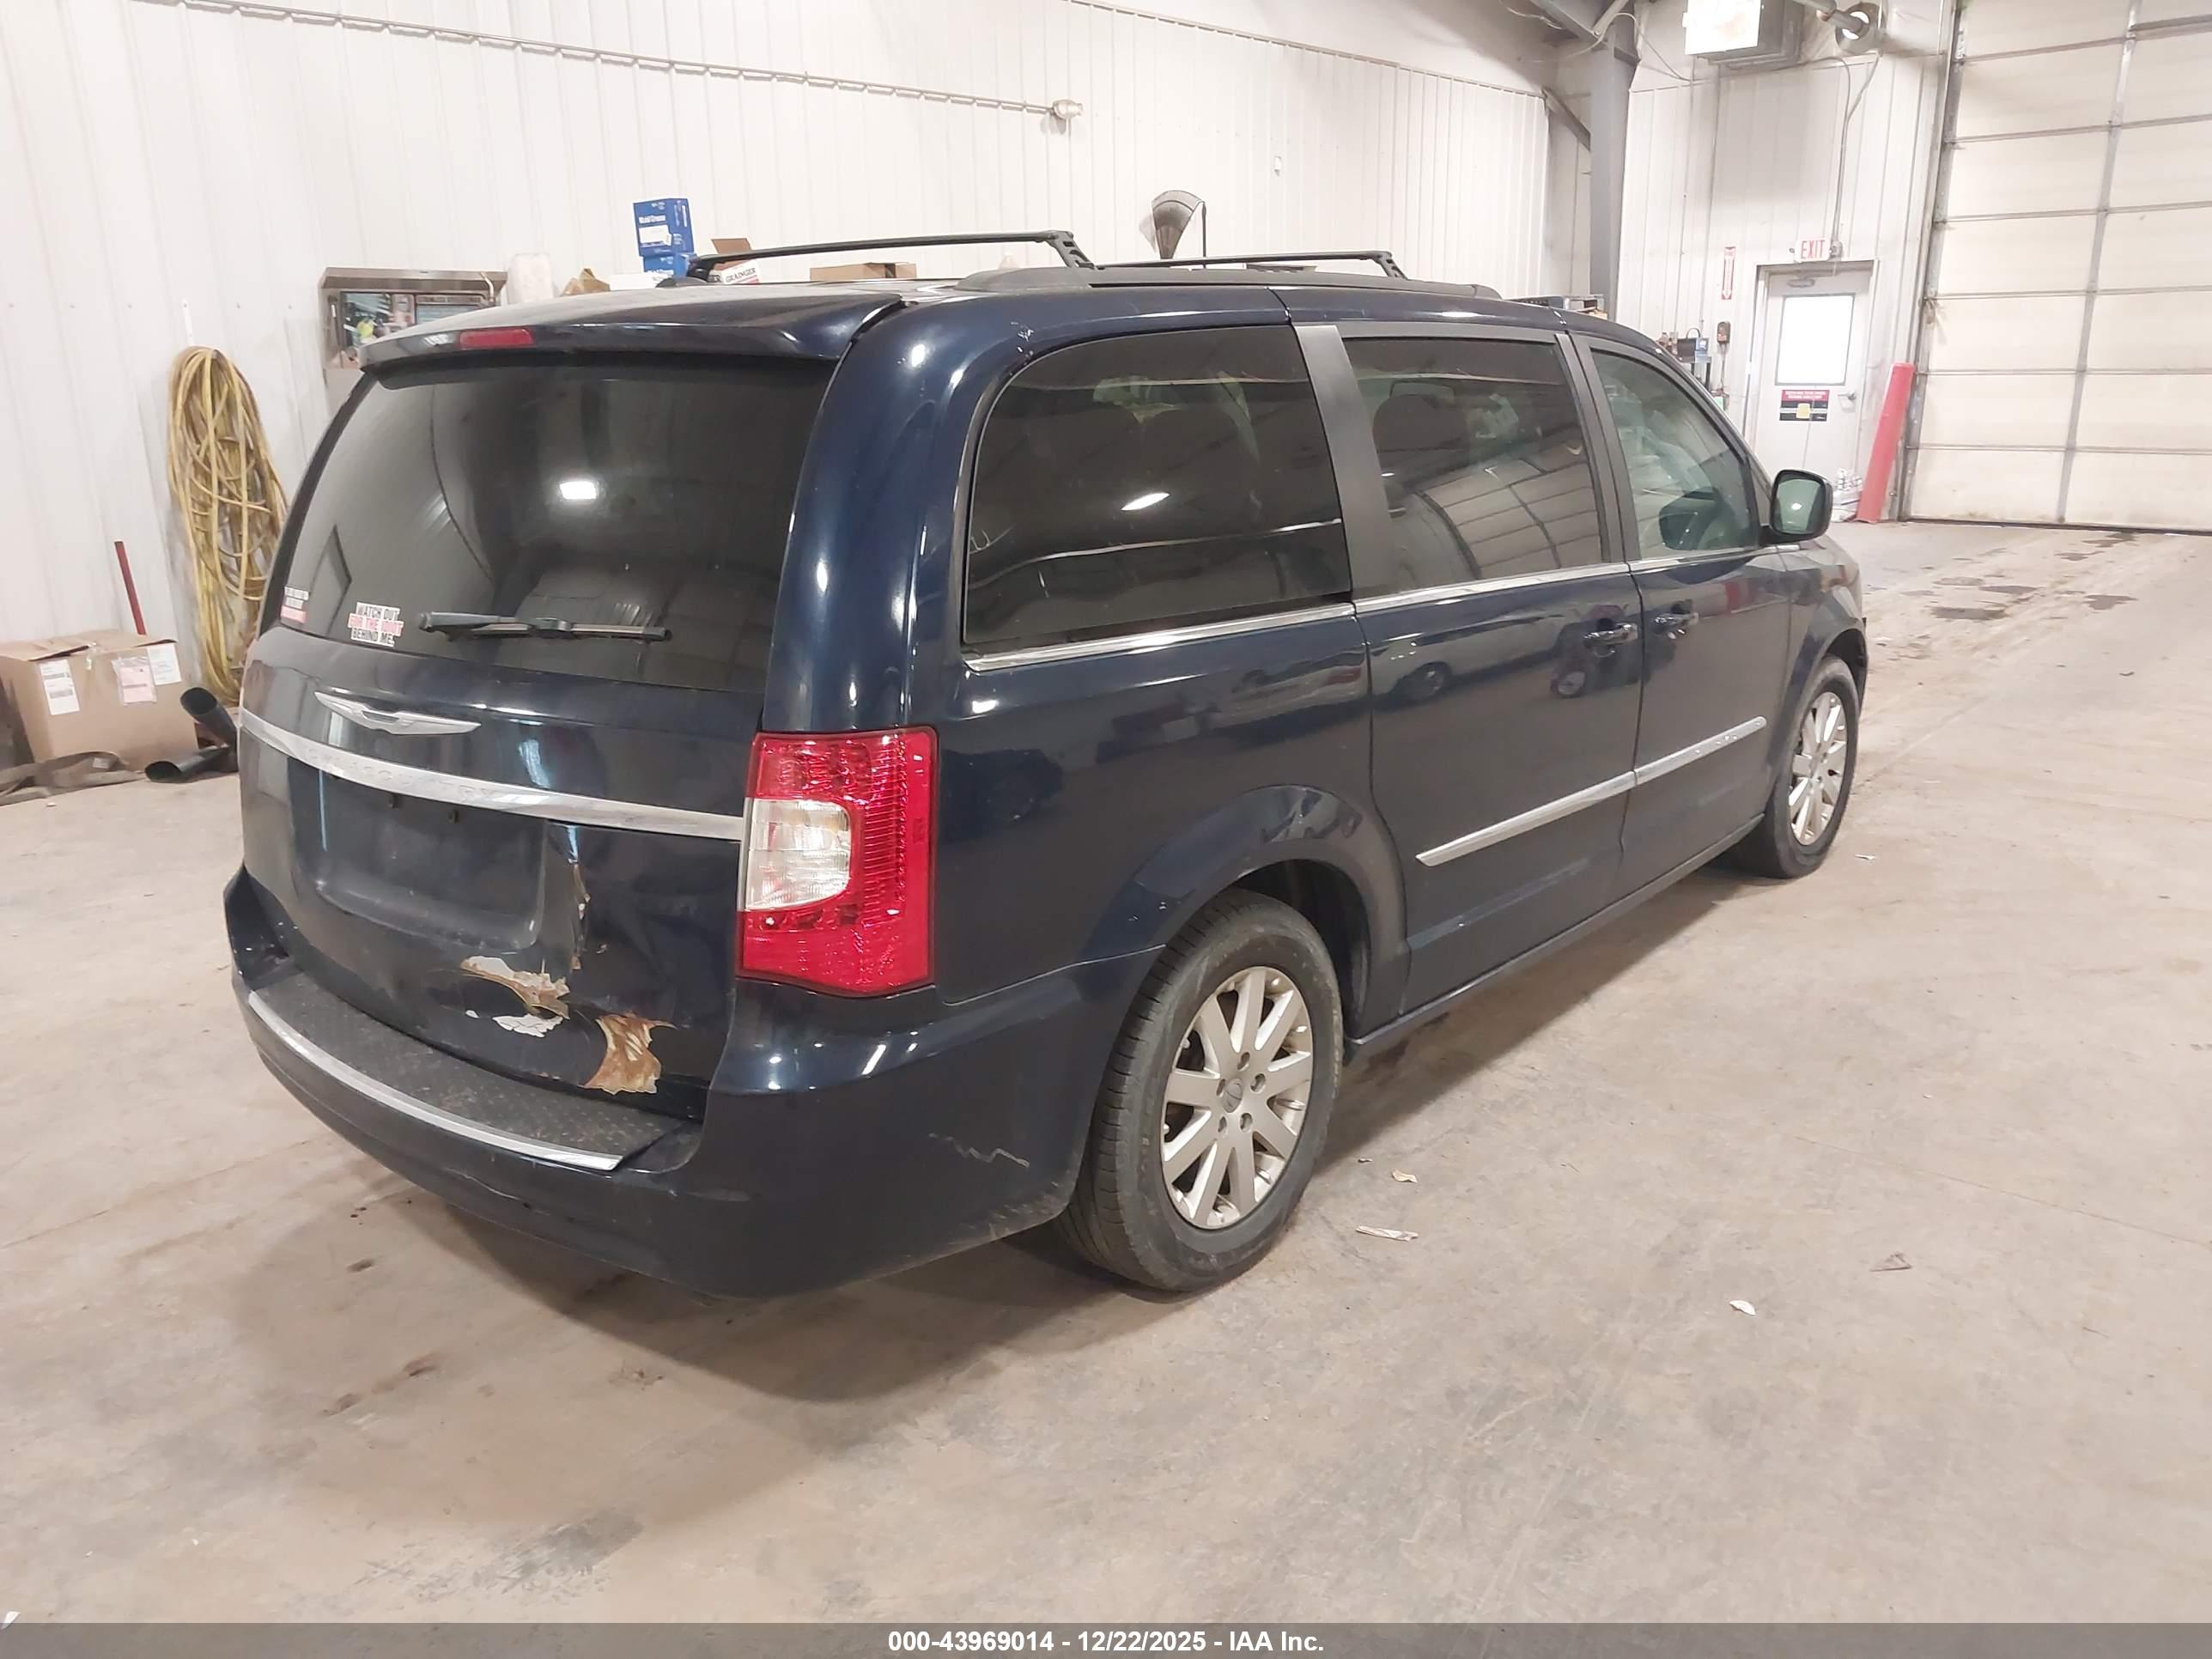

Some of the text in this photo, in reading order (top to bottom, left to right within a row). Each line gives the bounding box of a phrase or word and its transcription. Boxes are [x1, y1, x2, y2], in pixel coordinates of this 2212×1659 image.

[1801, 240, 1826, 259] EXIT
[356, 604, 399, 620] WATCH OUT
[353, 627, 379, 641] BEHIND
